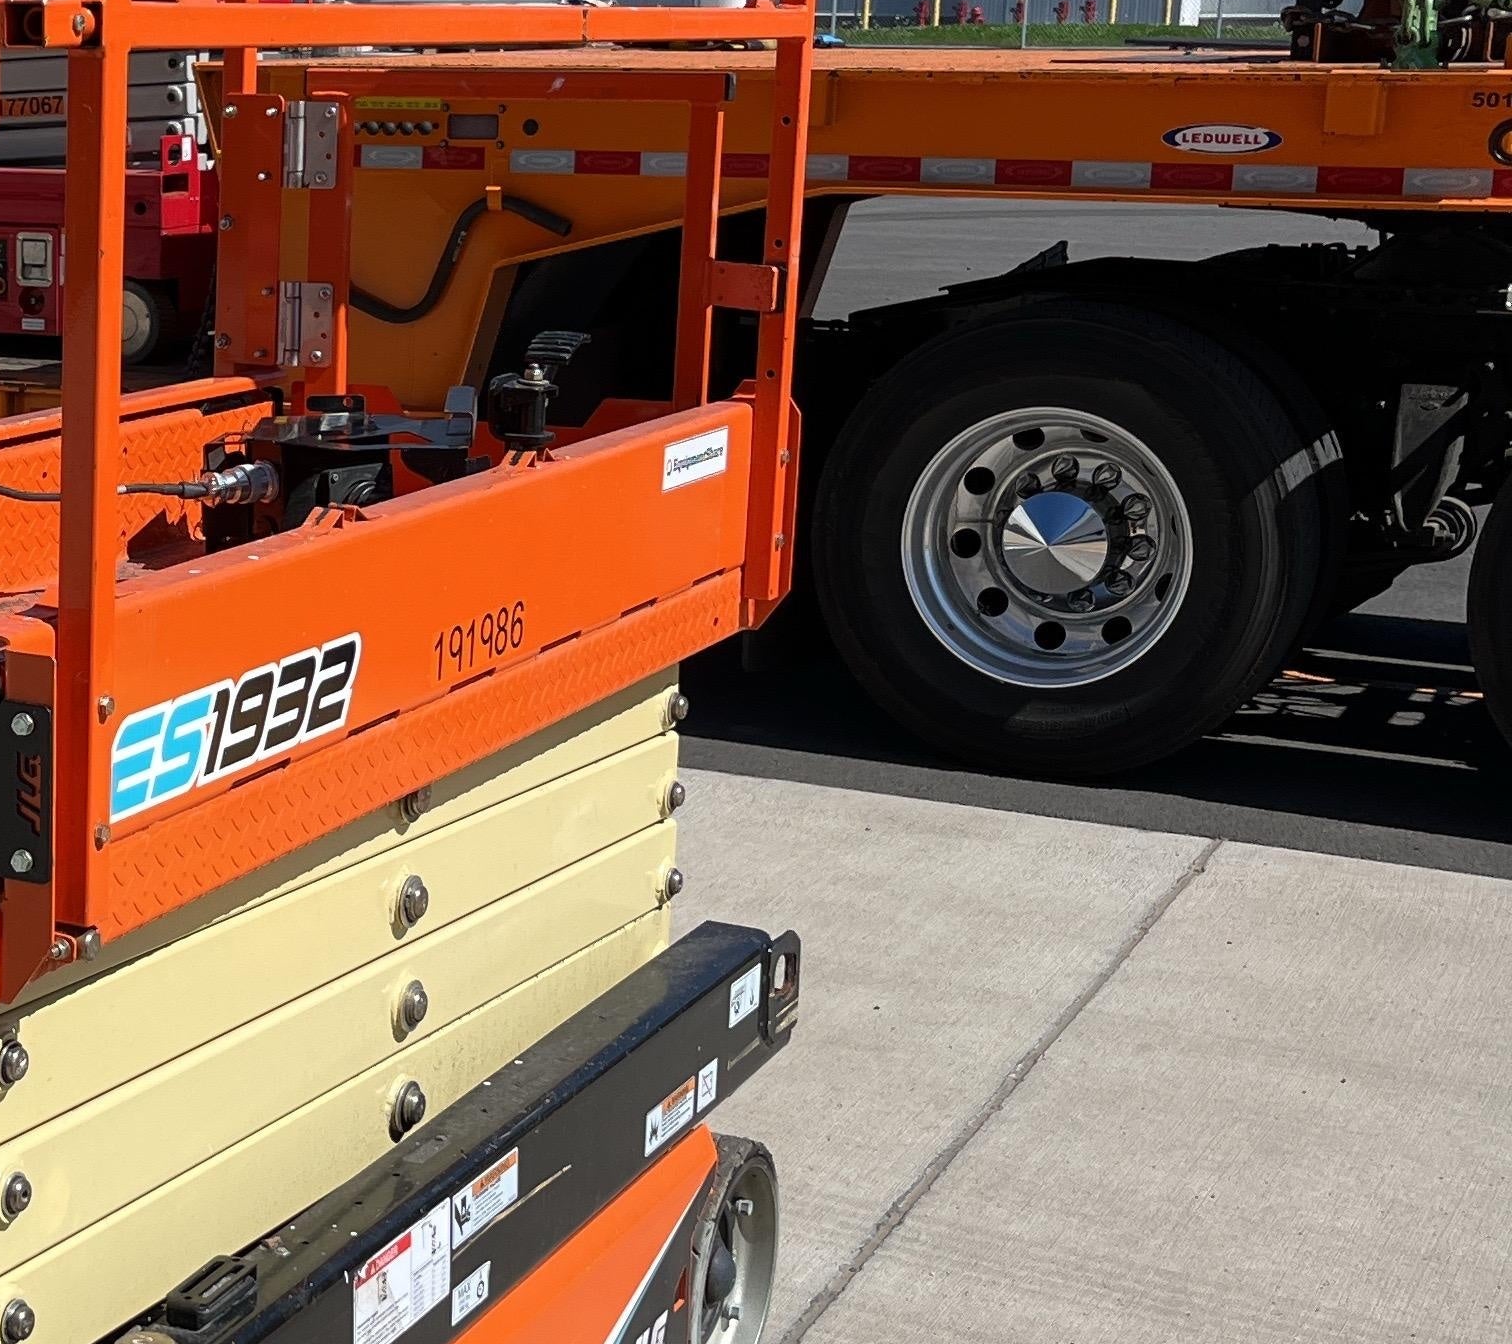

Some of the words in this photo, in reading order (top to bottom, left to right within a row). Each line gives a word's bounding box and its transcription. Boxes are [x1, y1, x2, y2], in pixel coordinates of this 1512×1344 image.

[1181, 131, 1263, 146] LEDWELL
[434, 600, 525, 682] 191986
[111, 640, 358, 817] ES1932
